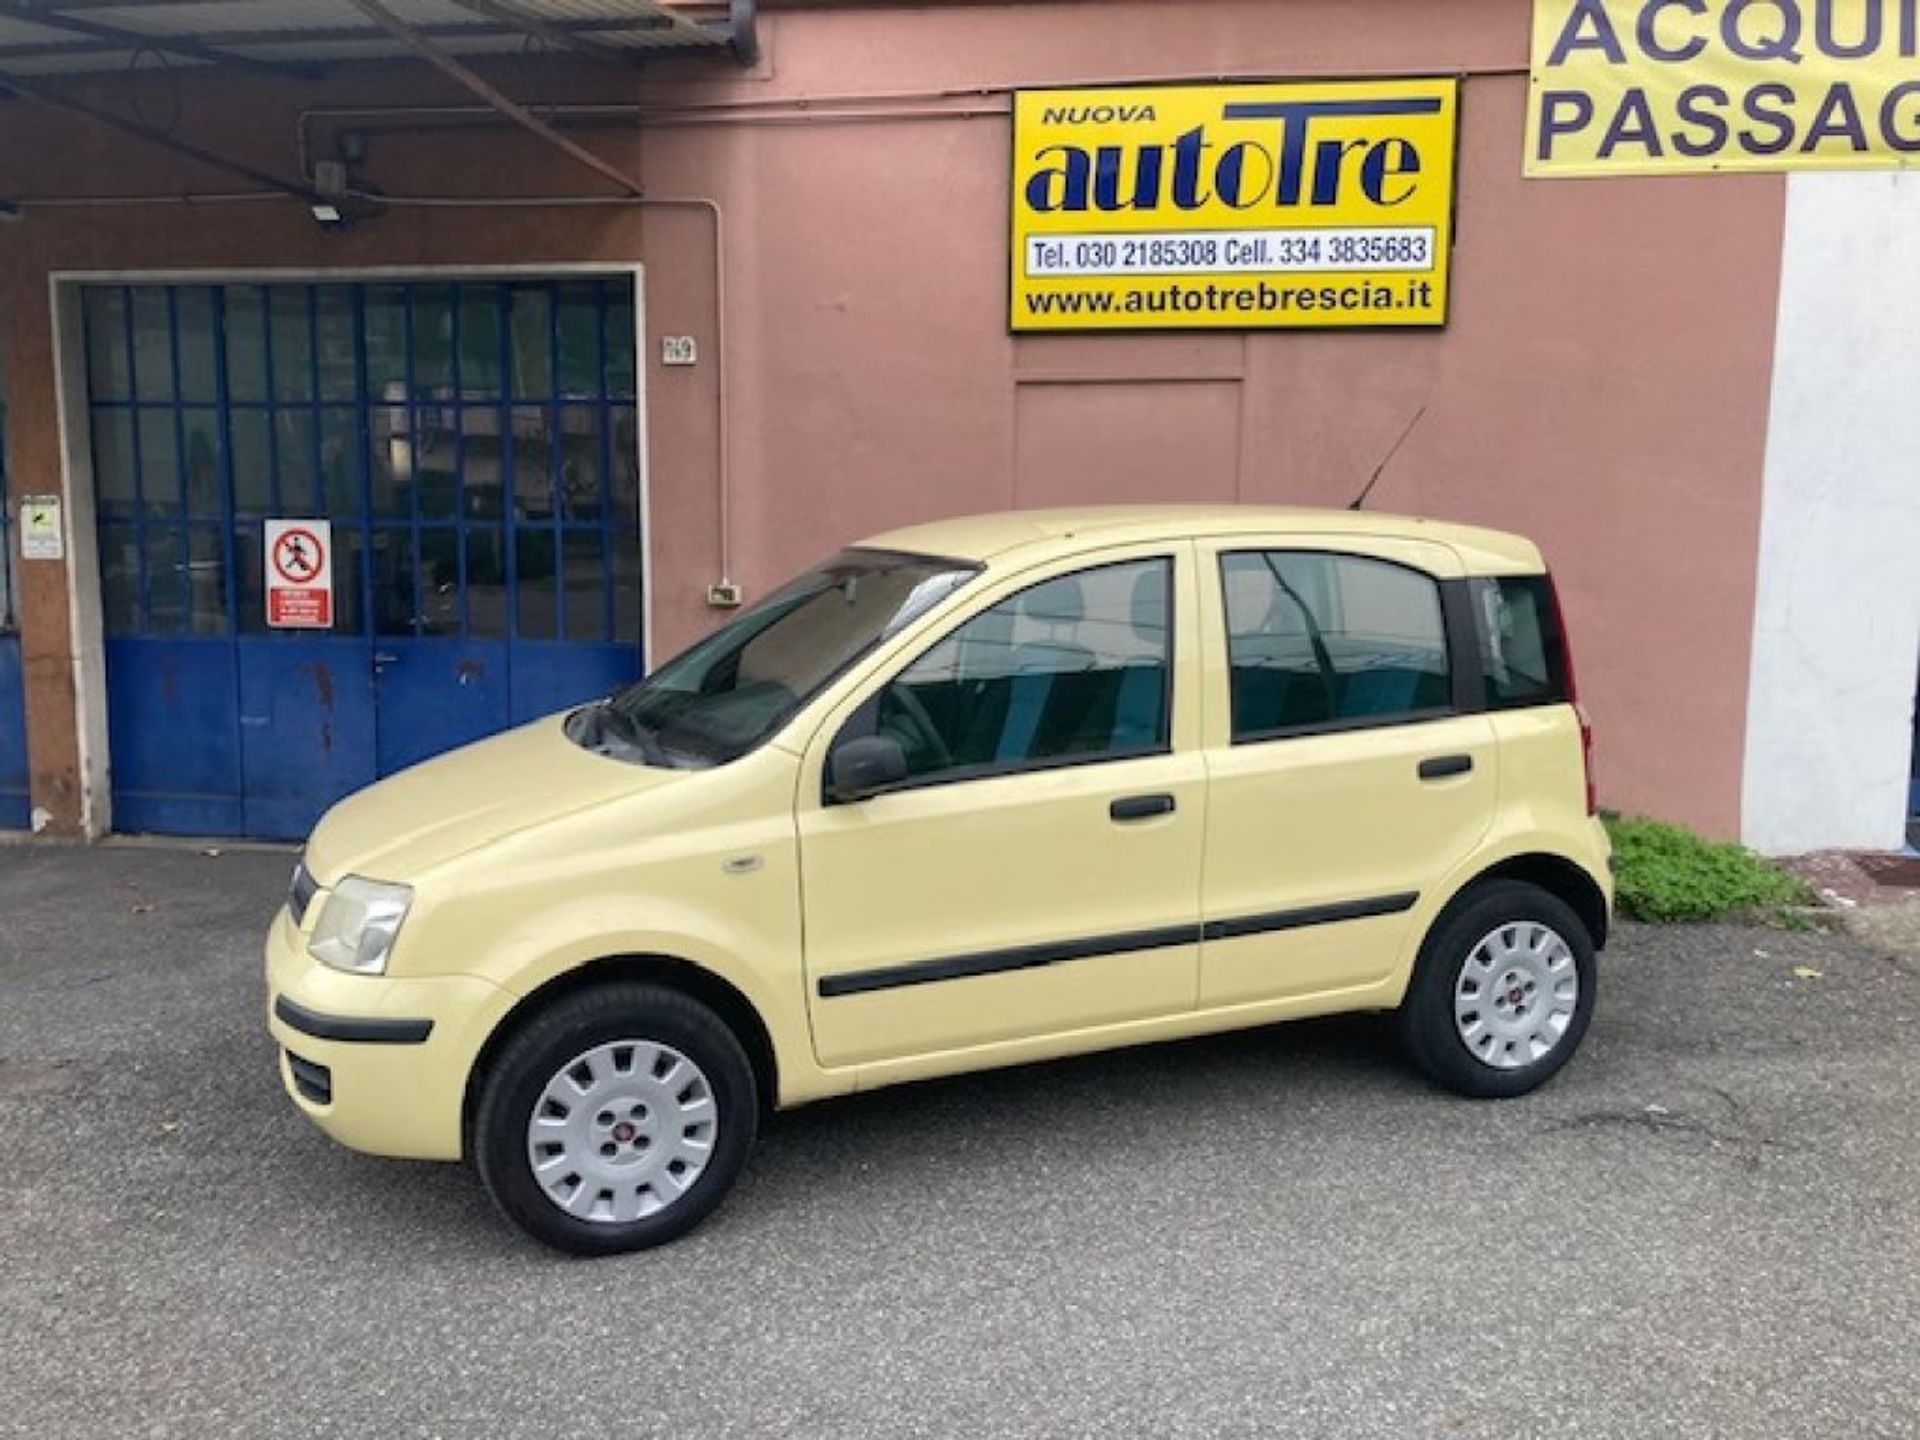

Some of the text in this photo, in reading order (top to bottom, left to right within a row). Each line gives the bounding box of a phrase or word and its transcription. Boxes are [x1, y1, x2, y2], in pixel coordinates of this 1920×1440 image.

[1546, 0, 1916, 66] ACQUI
[1043, 105, 1156, 125] NUOVA
[1537, 81, 1920, 160] PASSAG
[1034, 236, 1426, 268] Tel. 030 2185308 Cell. 334 3835683
[1026, 280, 1431, 314] www.autotrebrescia.it
